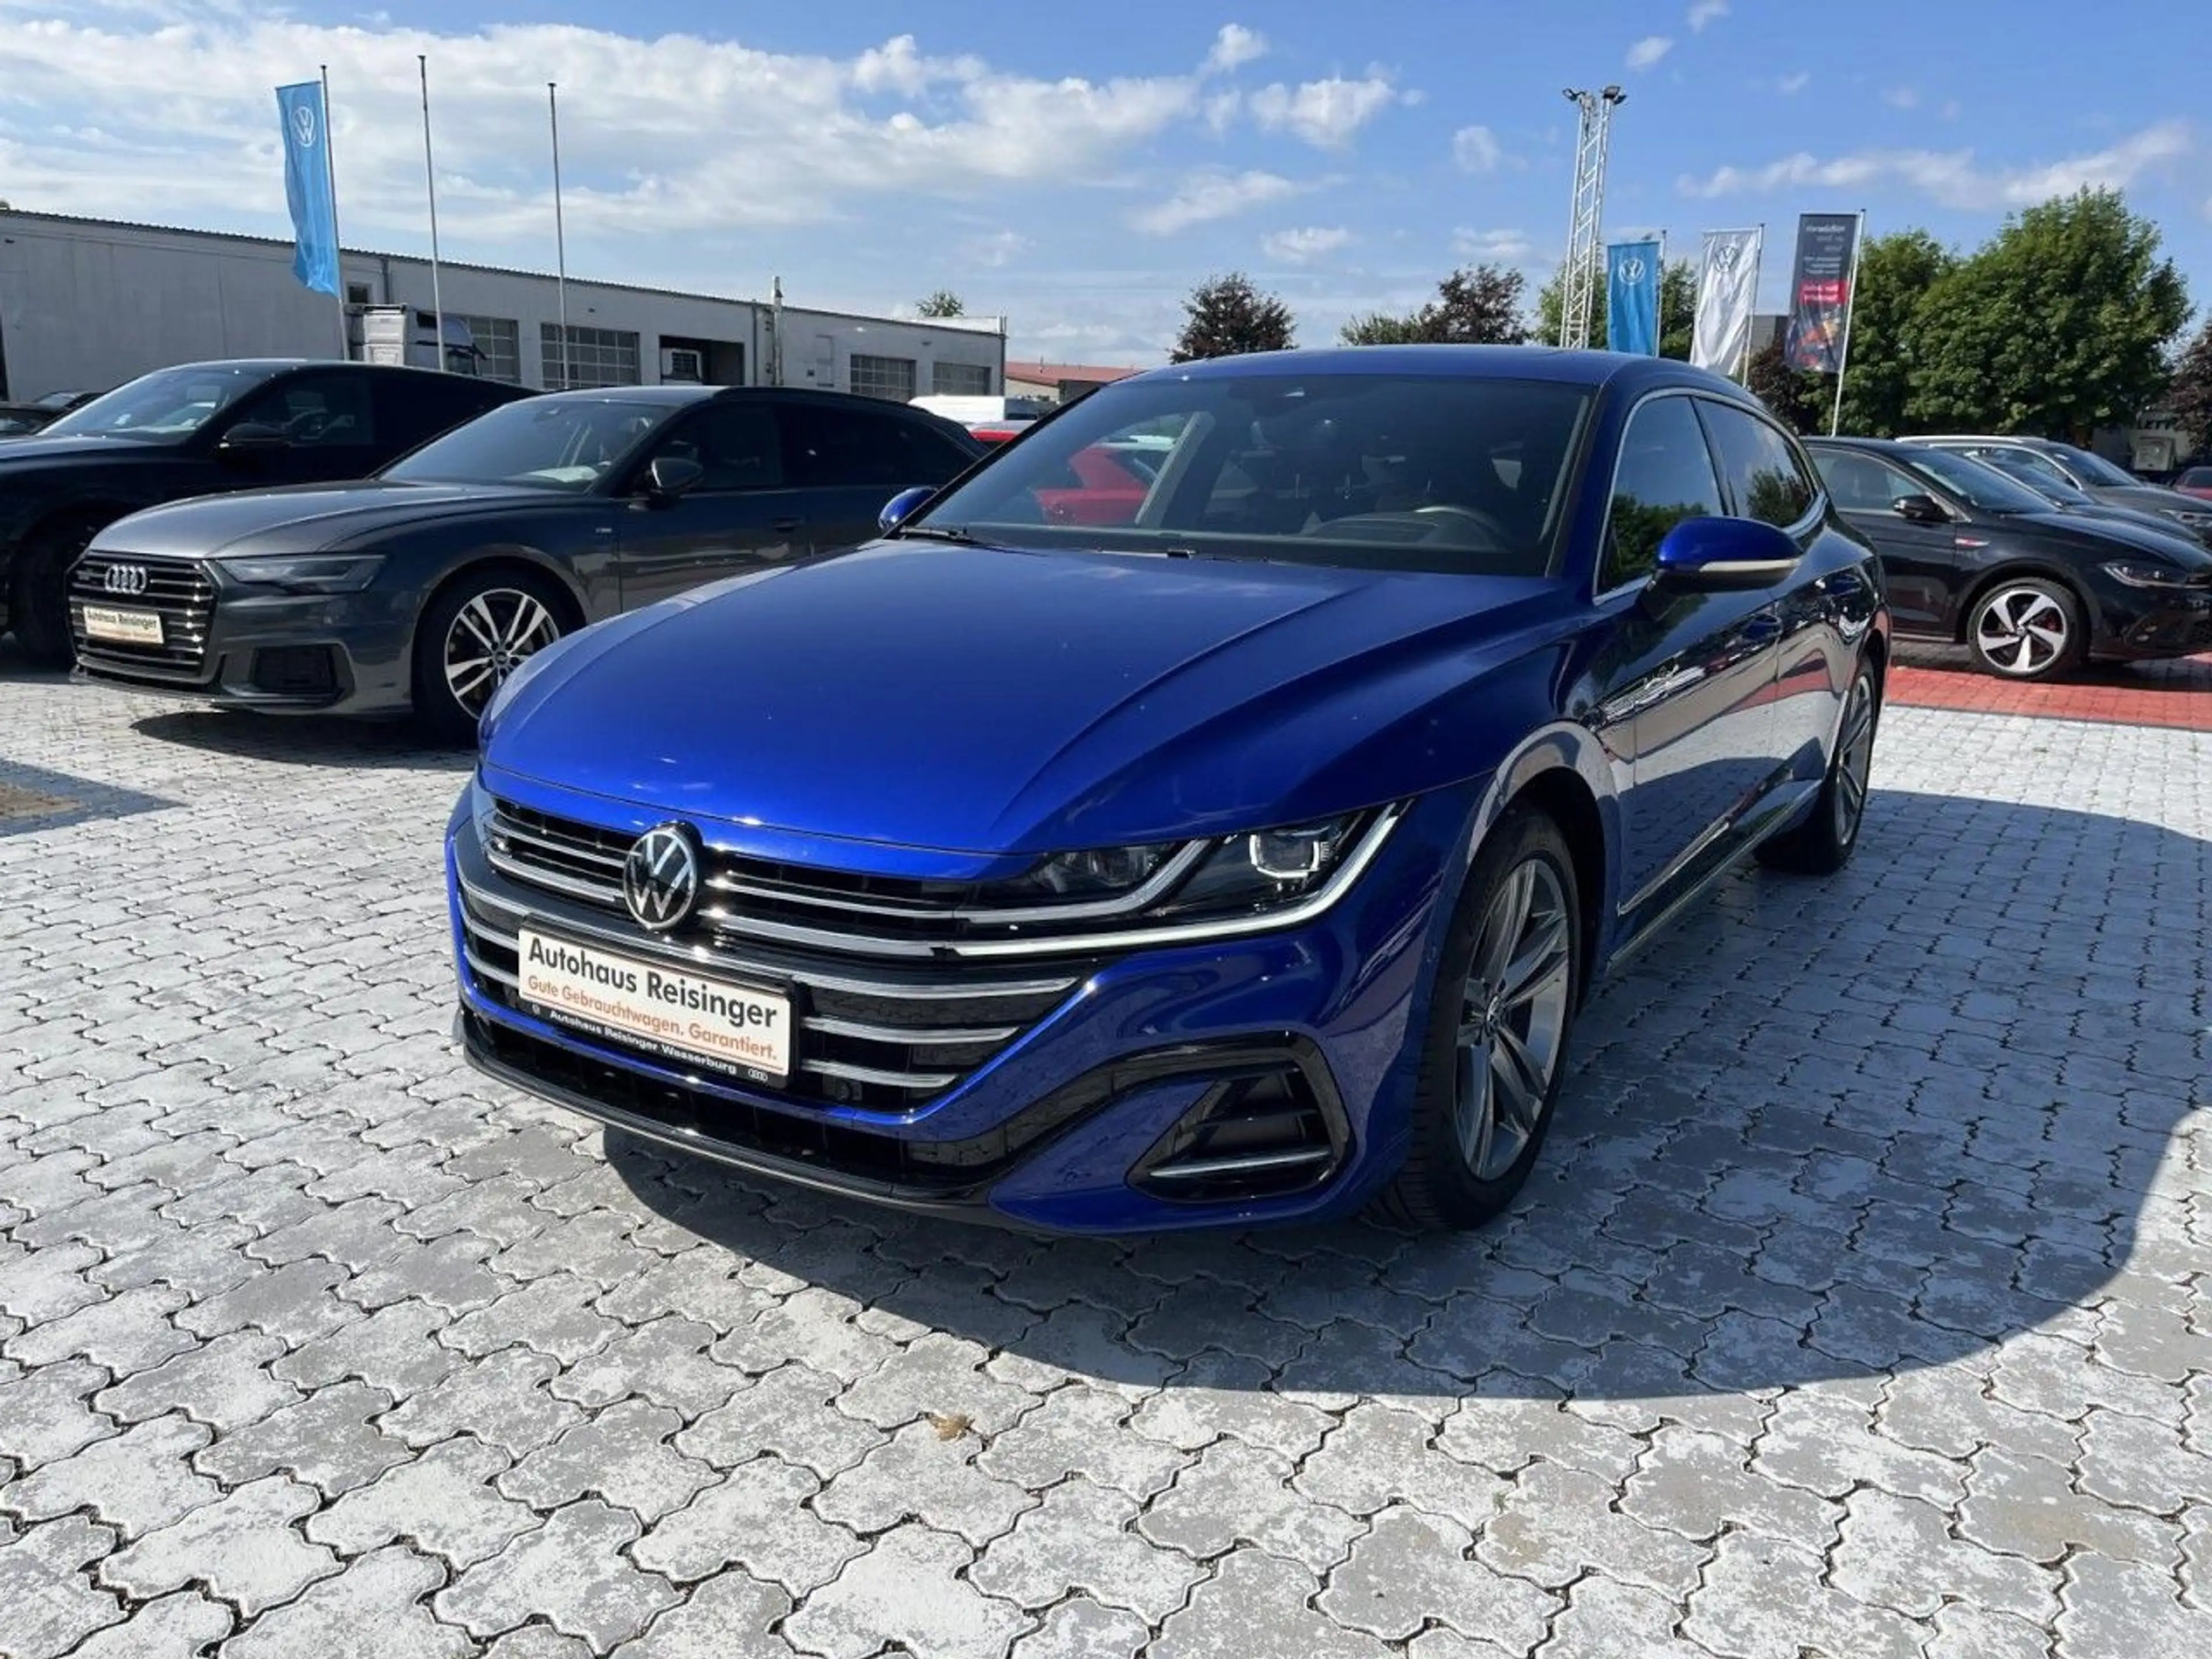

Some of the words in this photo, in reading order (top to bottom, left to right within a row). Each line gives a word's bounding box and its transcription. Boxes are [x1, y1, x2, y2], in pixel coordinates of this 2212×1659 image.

[528, 975, 558, 996] Gute
[690, 1022, 777, 1060] Garantiert.
[529, 937, 637, 992] Autohaus
[647, 971, 777, 1027] Reisinger
[550, 1010, 601, 1035] Autohaus
[604, 1027, 658, 1052] Reisinger
